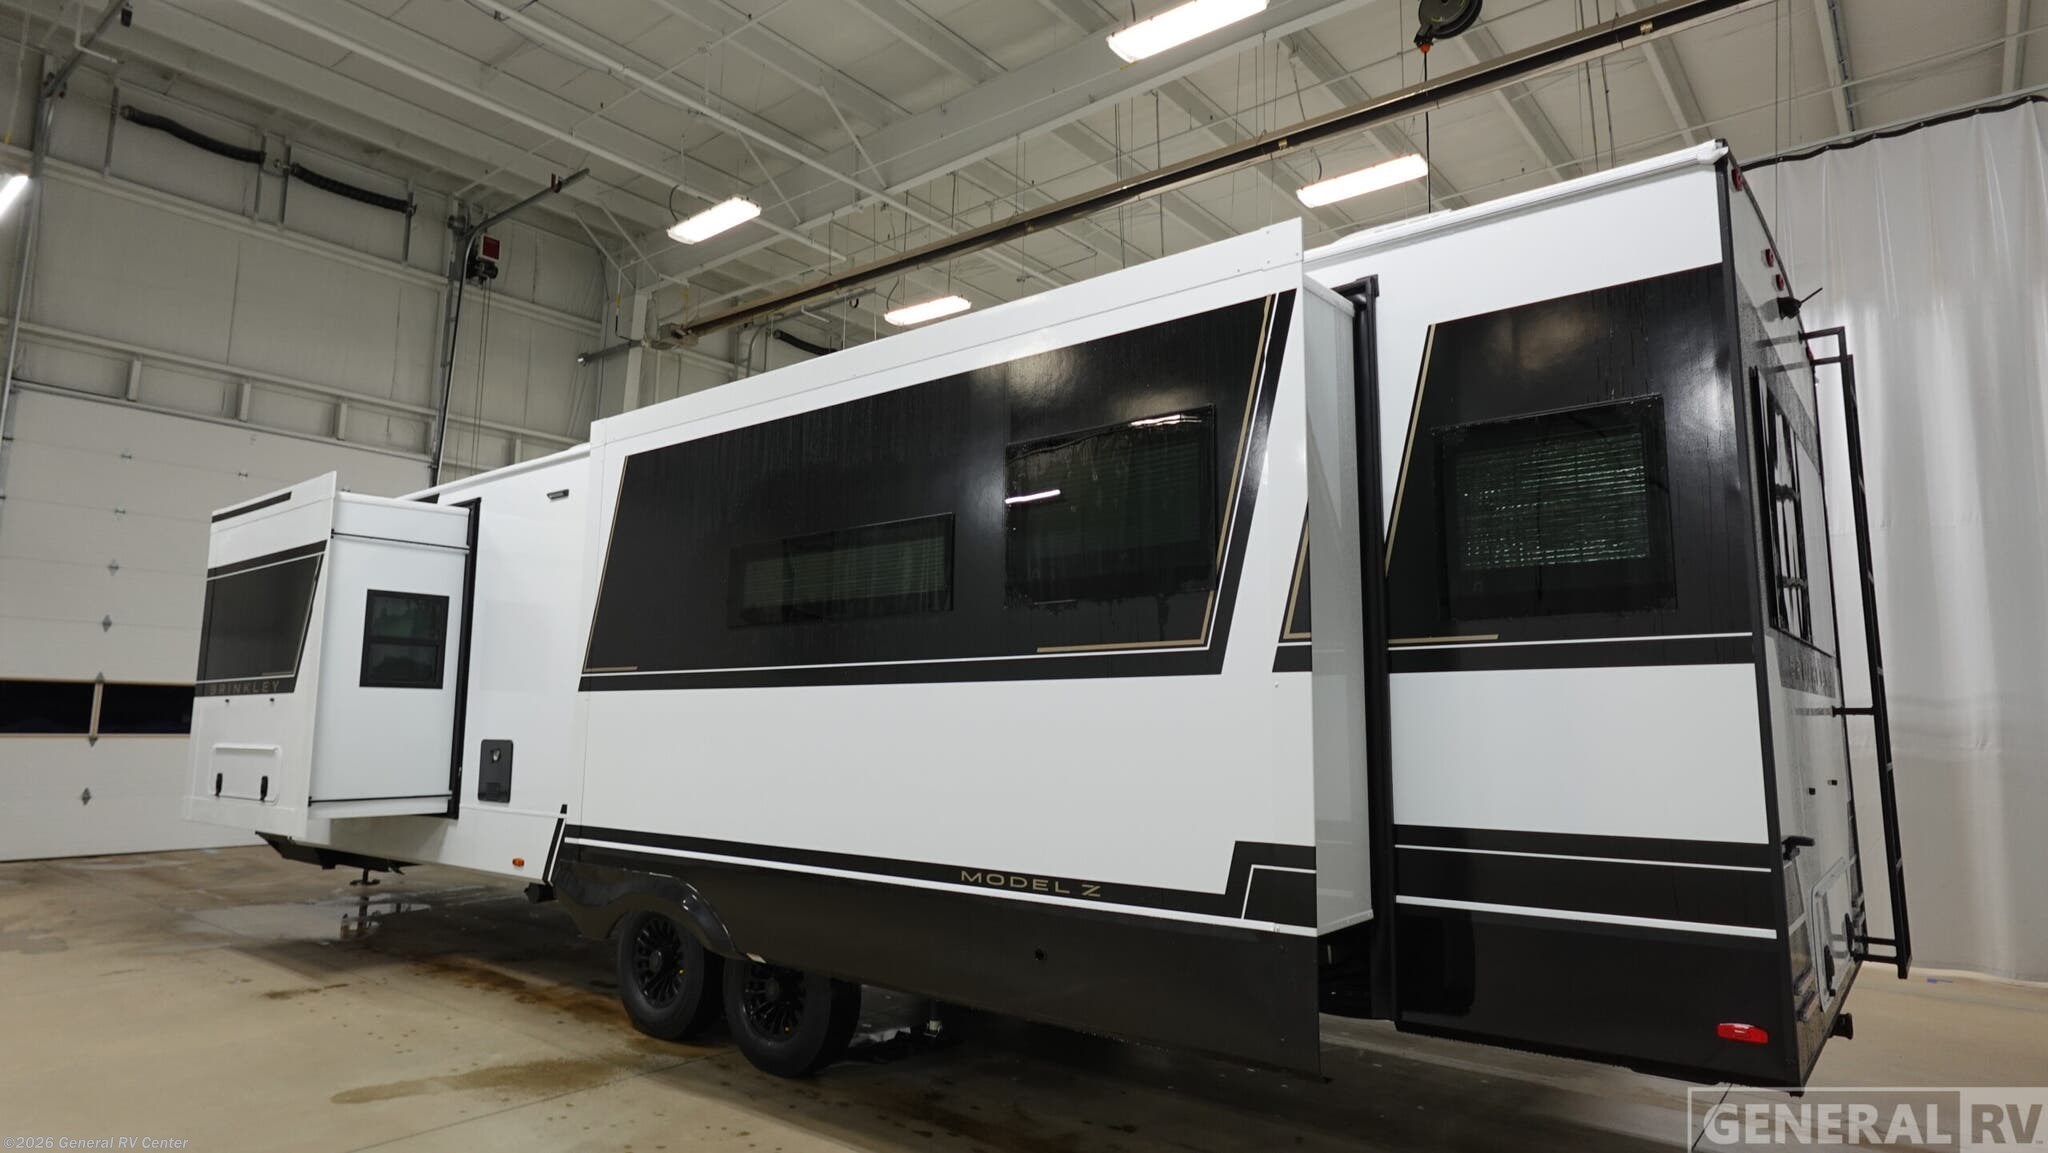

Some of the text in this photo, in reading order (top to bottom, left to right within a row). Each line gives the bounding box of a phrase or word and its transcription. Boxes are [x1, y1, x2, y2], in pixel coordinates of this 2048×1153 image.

[209, 680, 280, 695] BRINKLEY
[961, 870, 1101, 897] MODEL Z
